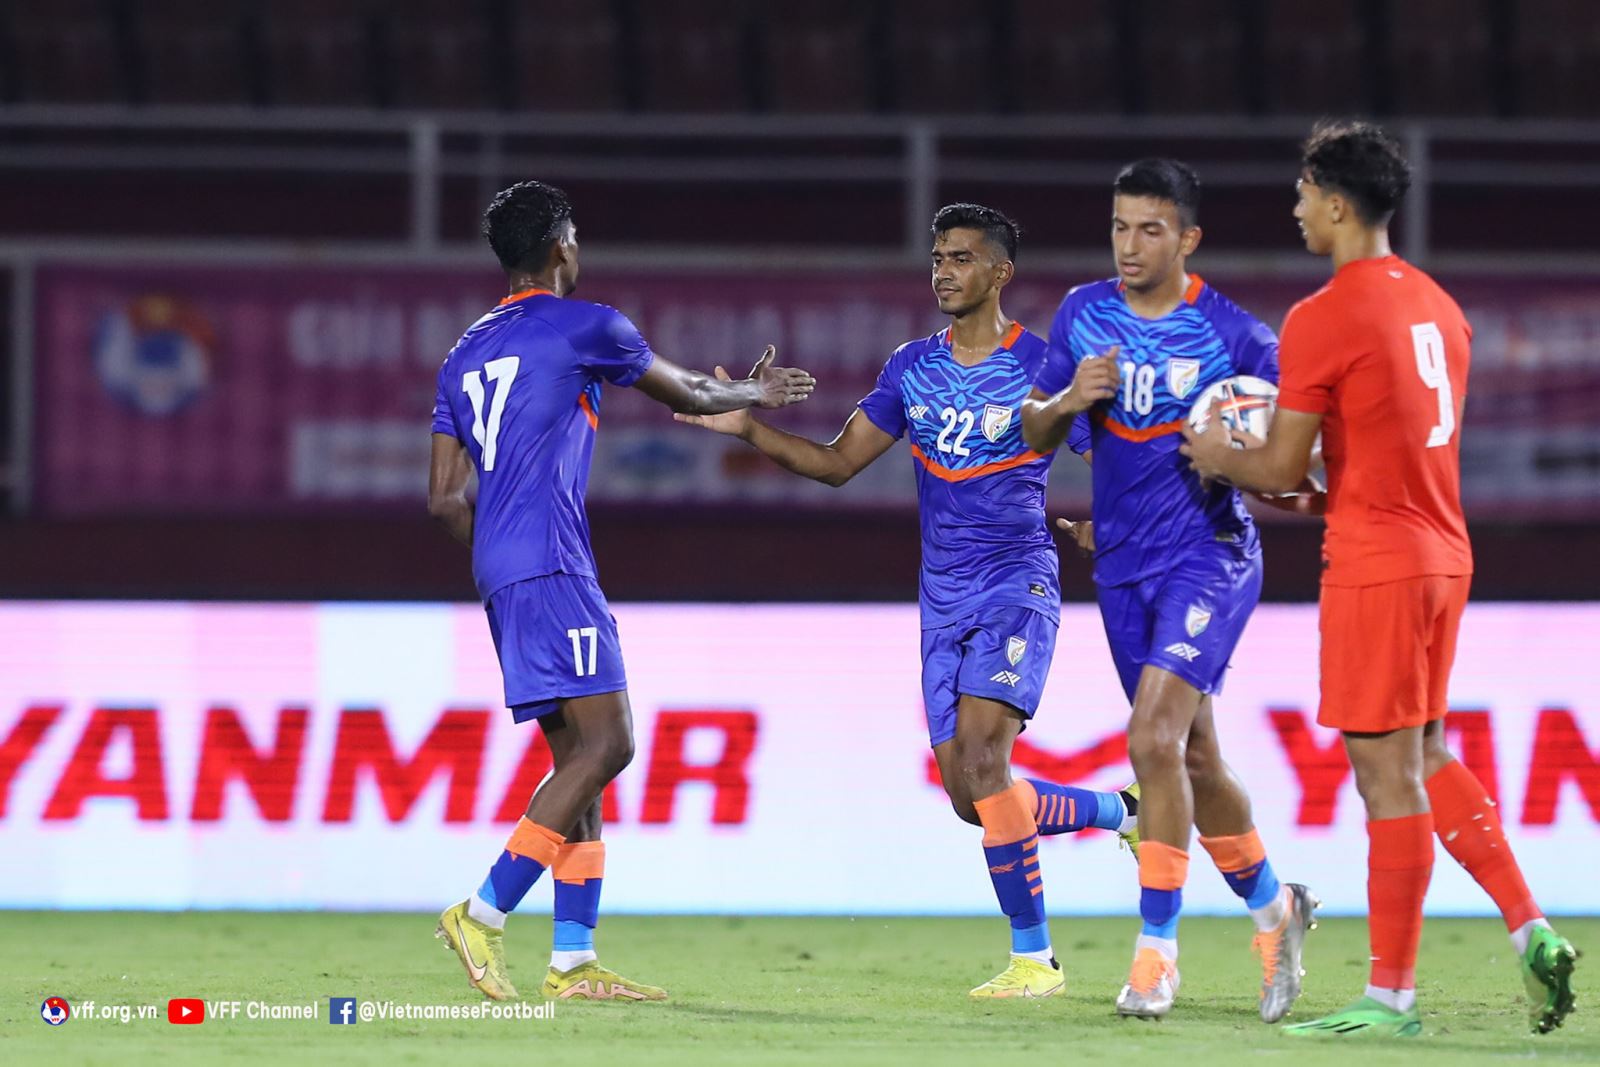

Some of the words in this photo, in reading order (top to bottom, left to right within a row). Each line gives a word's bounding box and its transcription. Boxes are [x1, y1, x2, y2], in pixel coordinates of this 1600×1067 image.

[1122, 363, 1155, 415] 18
[1411, 323, 1456, 447] 9
[462, 356, 521, 472] 17
[938, 407, 975, 456] 22
[567, 627, 598, 677] 17
